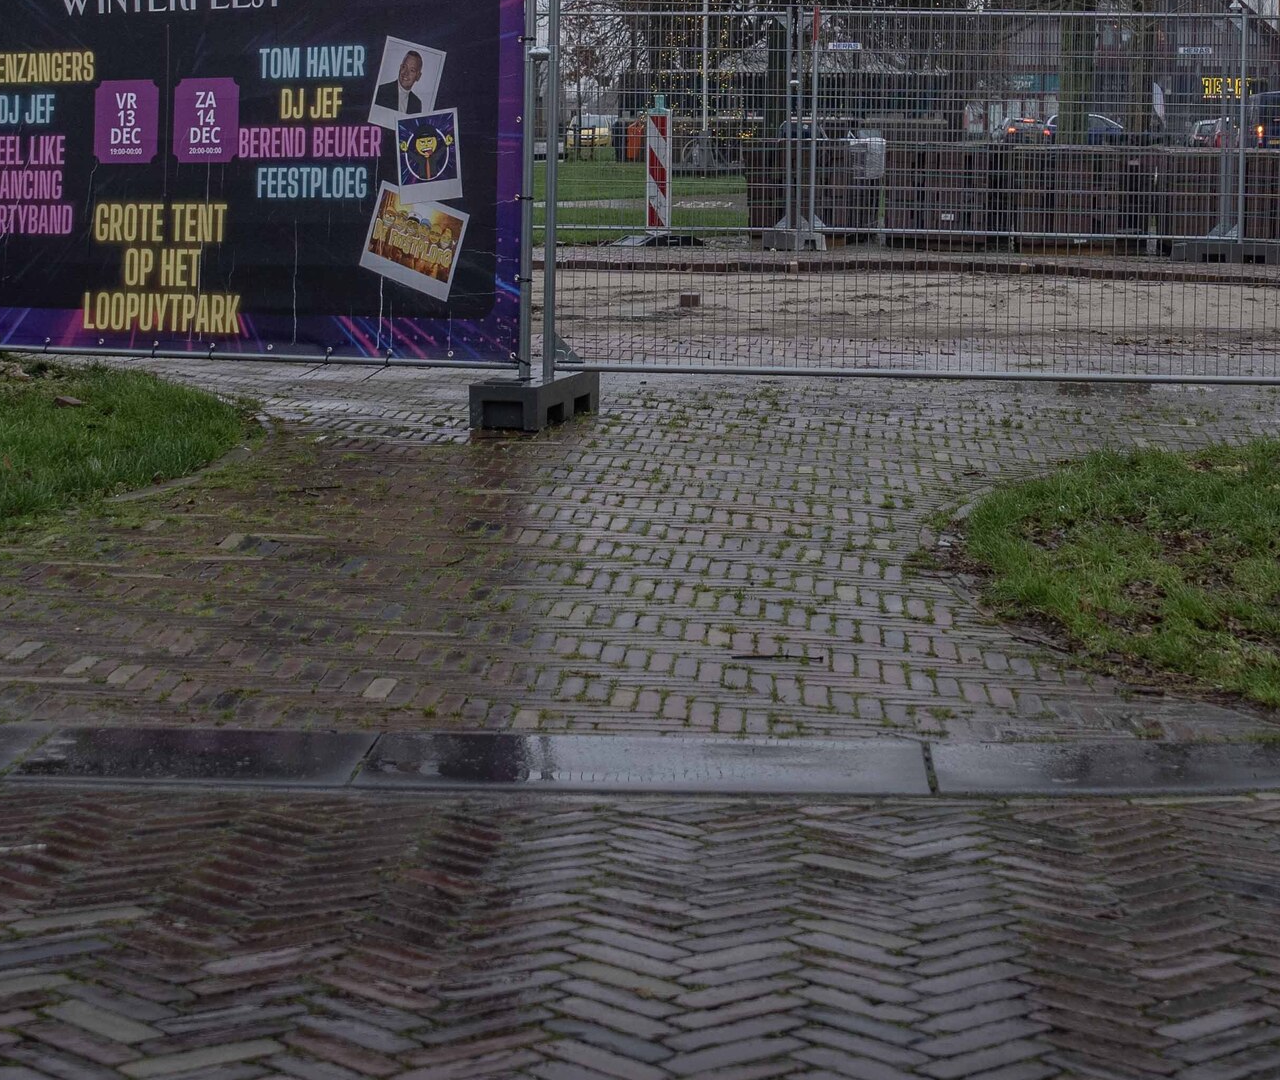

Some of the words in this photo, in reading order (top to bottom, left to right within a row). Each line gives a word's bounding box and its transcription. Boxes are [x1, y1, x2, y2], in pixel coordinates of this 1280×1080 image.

[259, 47, 300, 79] TOM
[306, 45, 365, 77] HAVER
[25, 94, 55, 124] JEF
[116, 92, 137, 109] VR
[195, 91, 217, 108] ZA
[280, 88, 305, 119] DJ
[310, 87, 343, 118] JEF
[117, 110, 136, 126] 13
[197, 109, 216, 125] 14
[30, 135, 66, 165] LIKE
[110, 128, 141, 145] DEC
[189, 127, 221, 143] DEC
[238, 127, 306, 158] BEREND
[312, 126, 382, 157] BEUKER
[257, 167, 367, 199] FEESTPLOEG
[95, 203, 165, 242] GROTE
[171, 204, 228, 242] TENT
[125, 248, 154, 286] OP
[161, 248, 202, 287] HET
[83, 292, 241, 334] LOOPUYTPARK
